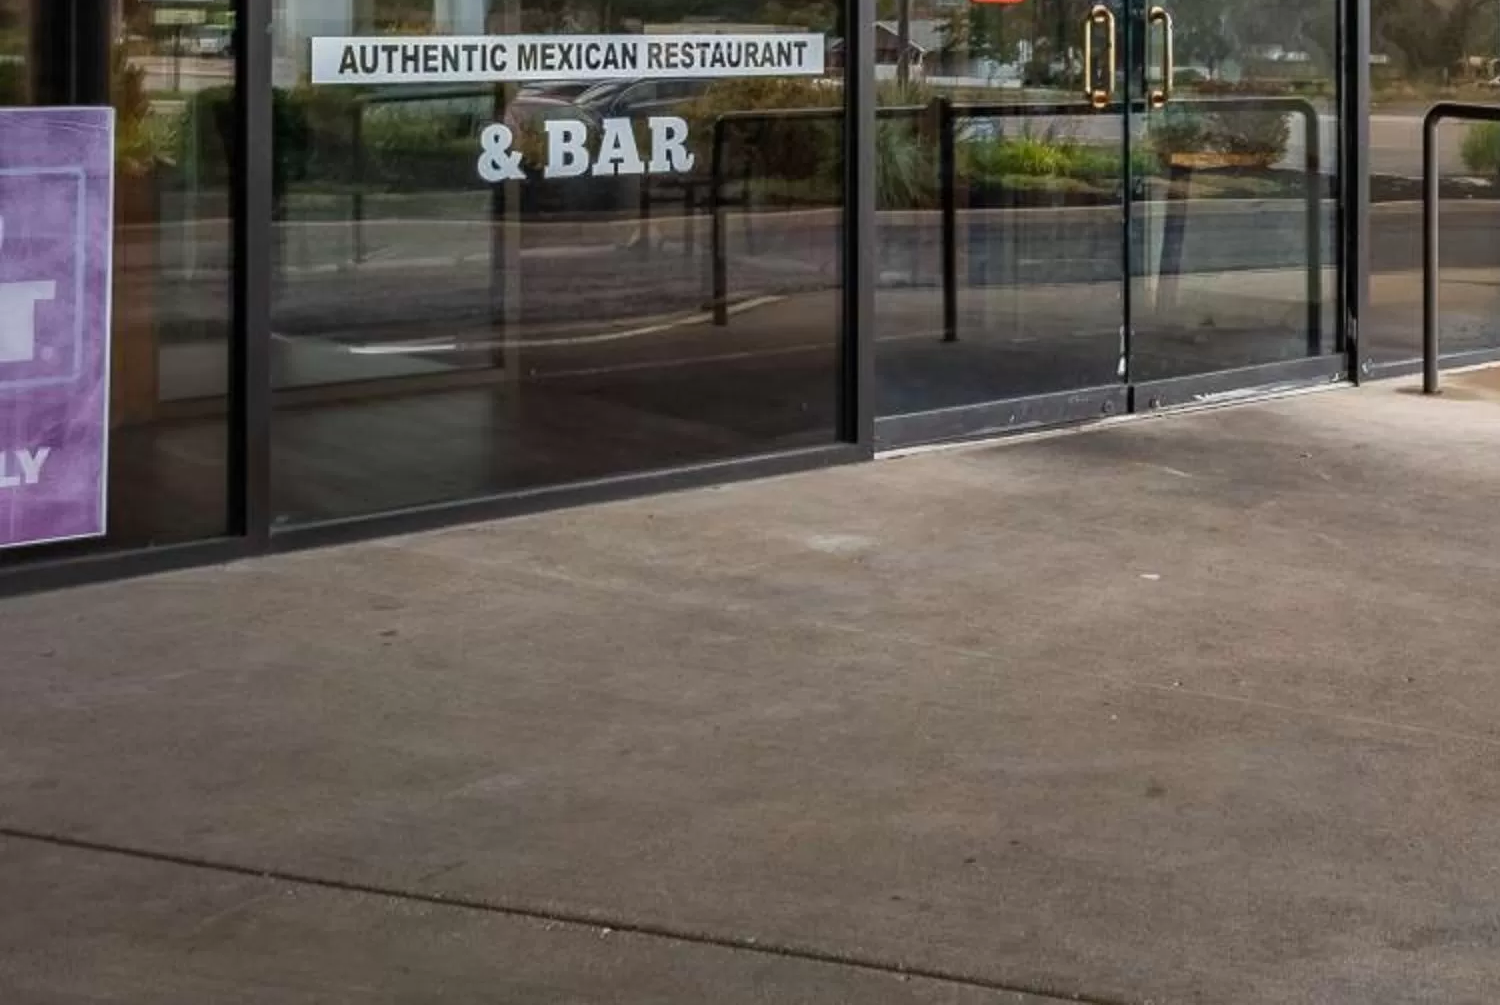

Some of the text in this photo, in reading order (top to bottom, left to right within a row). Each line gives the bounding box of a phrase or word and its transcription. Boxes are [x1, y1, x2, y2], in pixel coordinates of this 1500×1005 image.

[338, 40, 808, 75] AUTHENTIC MEXICAN RESTAURANT
[477, 115, 695, 183] & BAR
